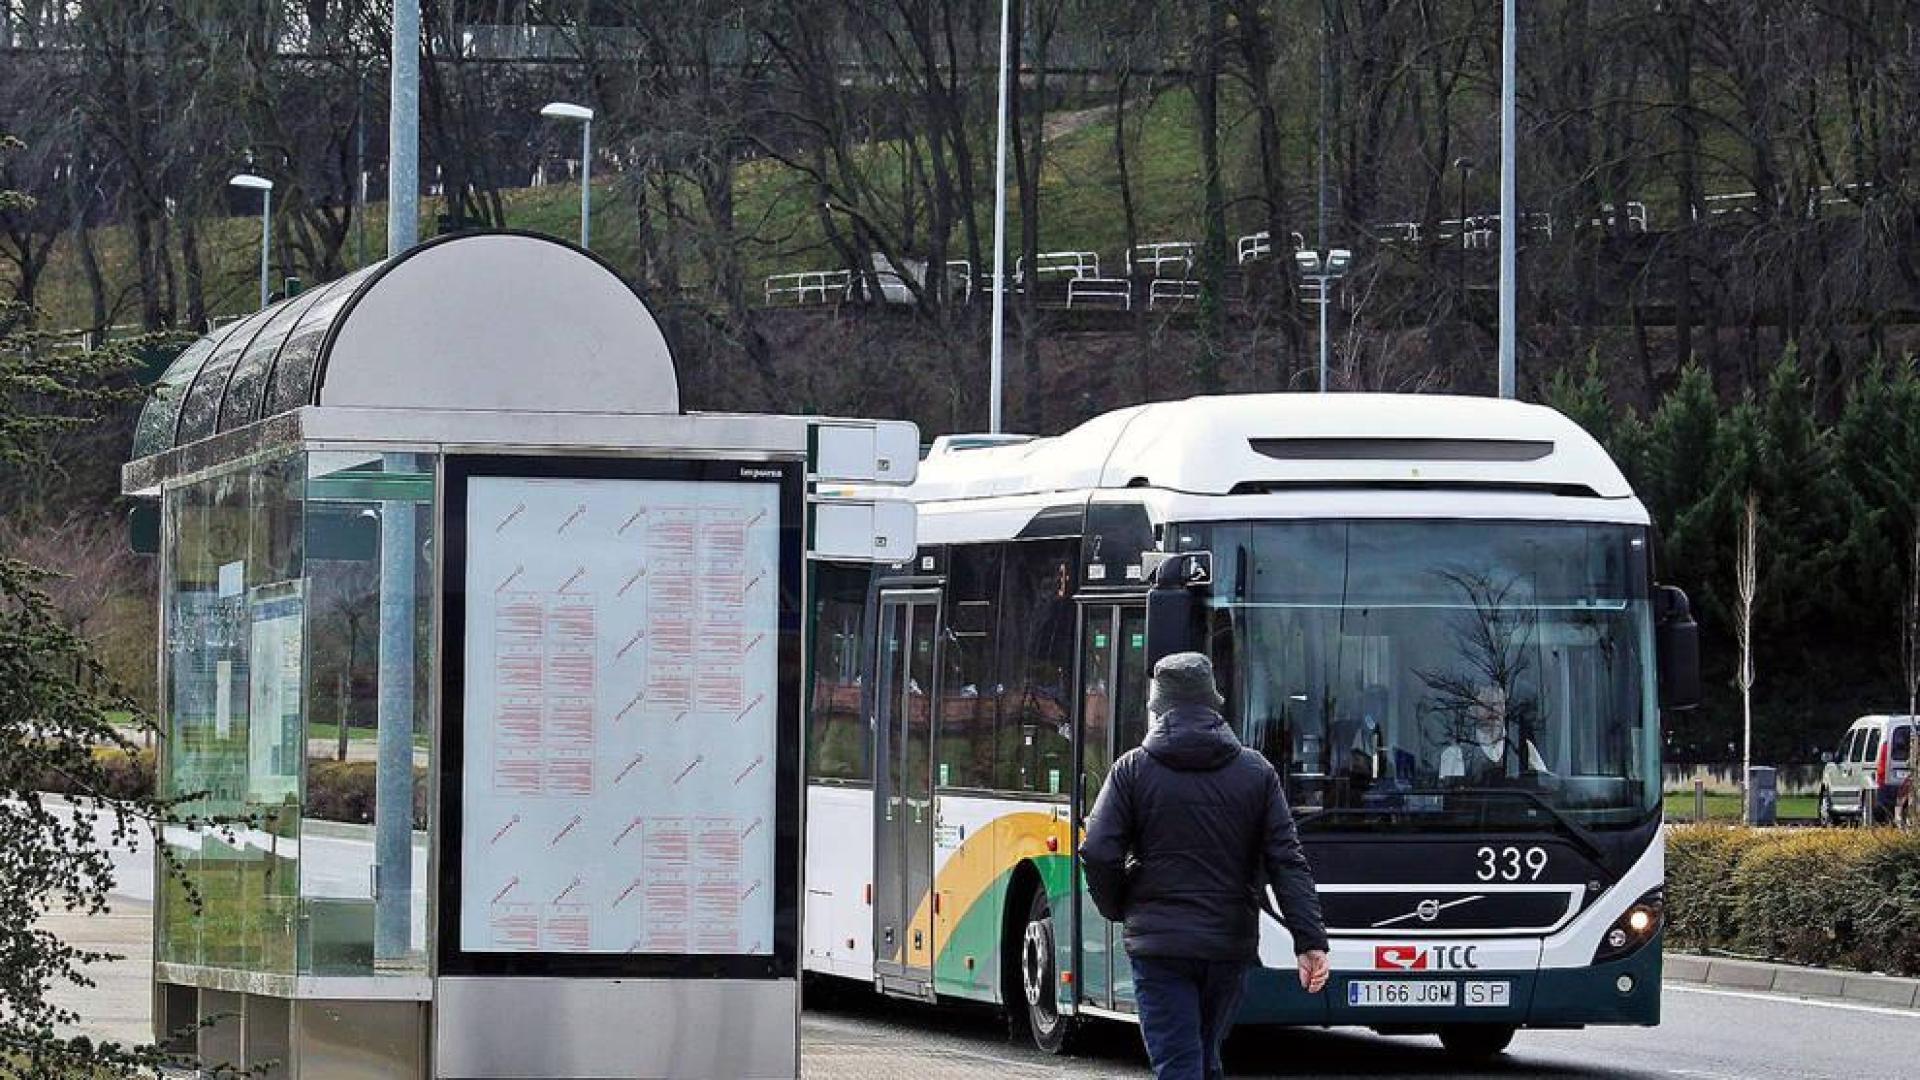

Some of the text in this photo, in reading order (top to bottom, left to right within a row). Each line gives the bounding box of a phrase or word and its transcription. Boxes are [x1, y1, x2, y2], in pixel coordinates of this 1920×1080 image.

[1476, 846, 1548, 881] 339
[1433, 945, 1478, 969] TCC
[1364, 984, 1409, 1003] 1166
